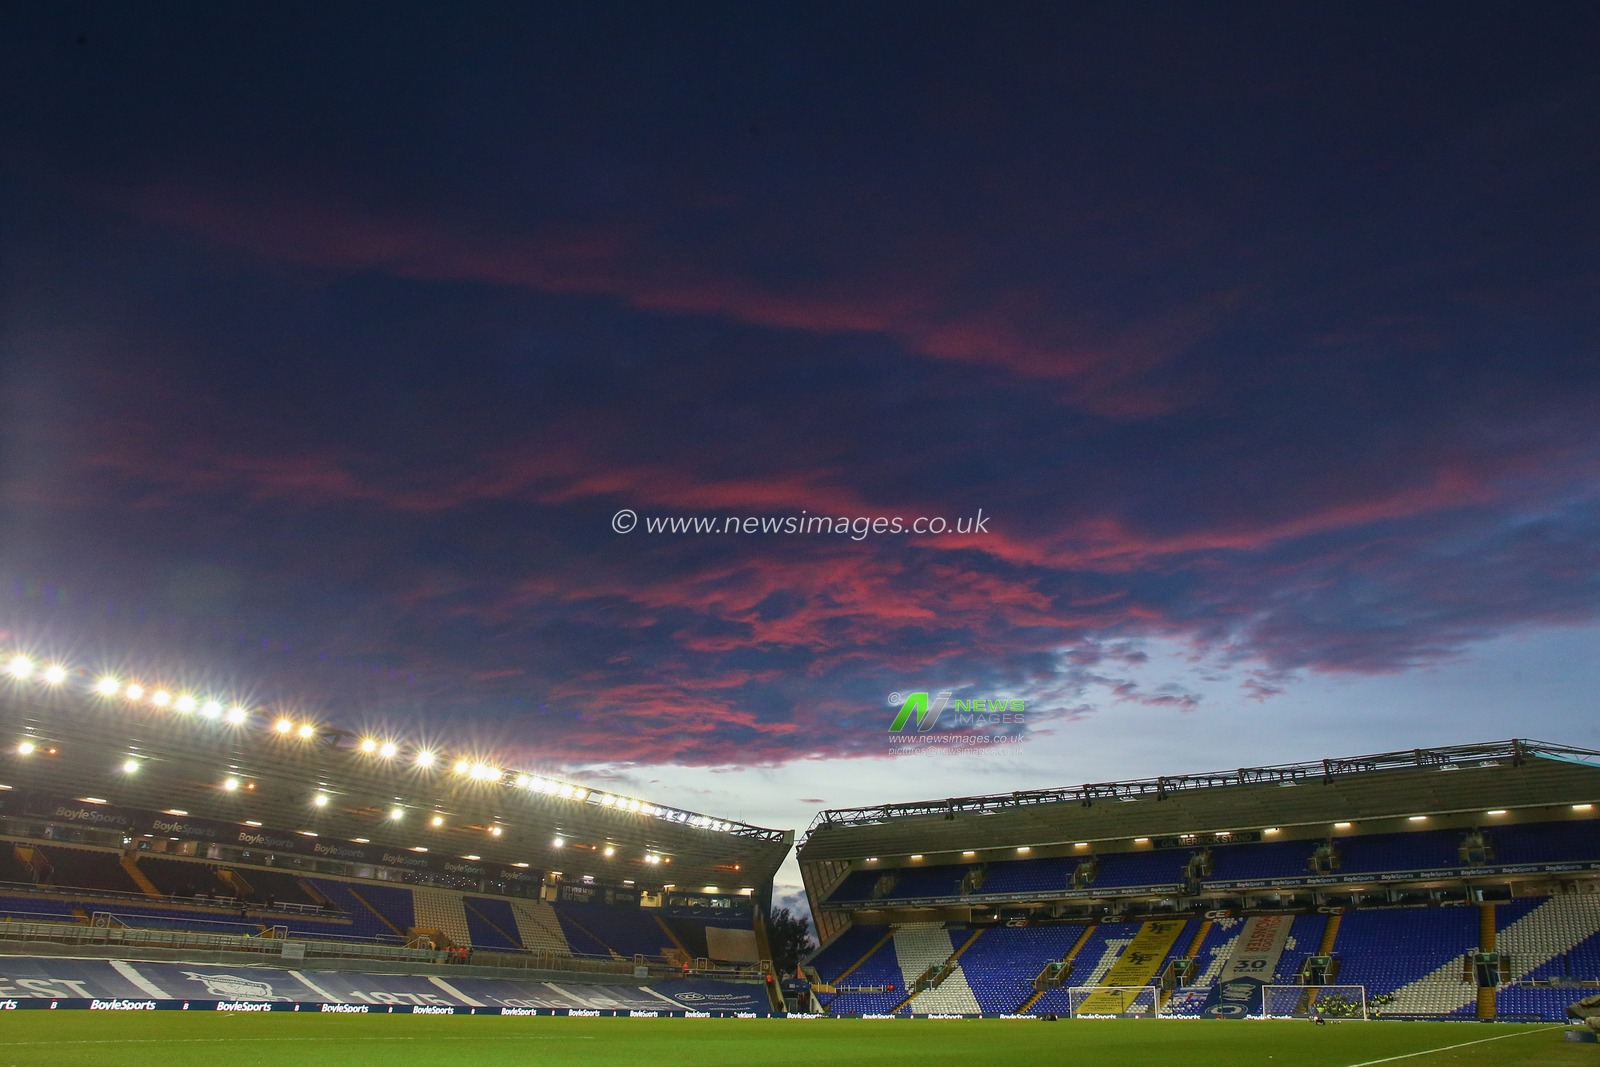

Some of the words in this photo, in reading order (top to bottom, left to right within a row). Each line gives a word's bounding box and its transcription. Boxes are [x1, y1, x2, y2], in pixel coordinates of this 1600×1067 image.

[56, 807, 127, 826] BoyleSports
[153, 820, 215, 838] BoyleSports
[238, 832, 294, 848] BoyleSports
[1178, 836, 1219, 846] MERRICK
[1222, 833, 1252, 844] STAND
[315, 843, 365, 858] BoyleSports
[382, 853, 428, 867] BoyleSports
[444, 863, 486, 876] BoyleSports
[1421, 870, 1453, 878] BoyleSports
[1460, 868, 1495, 876] BoyleSports
[1502, 865, 1538, 874] BoyleSports
[1381, 872, 1414, 880] BoyleSports
[1234, 960, 1267, 969] 30
[90, 999, 156, 1011] BoyleSports
[216, 1001, 272, 1012] BoyleSports
[321, 1003, 369, 1013] BoyleSports
[412, 1005, 454, 1015] BoyleSports
[501, 1008, 537, 1016] BoyleSports
